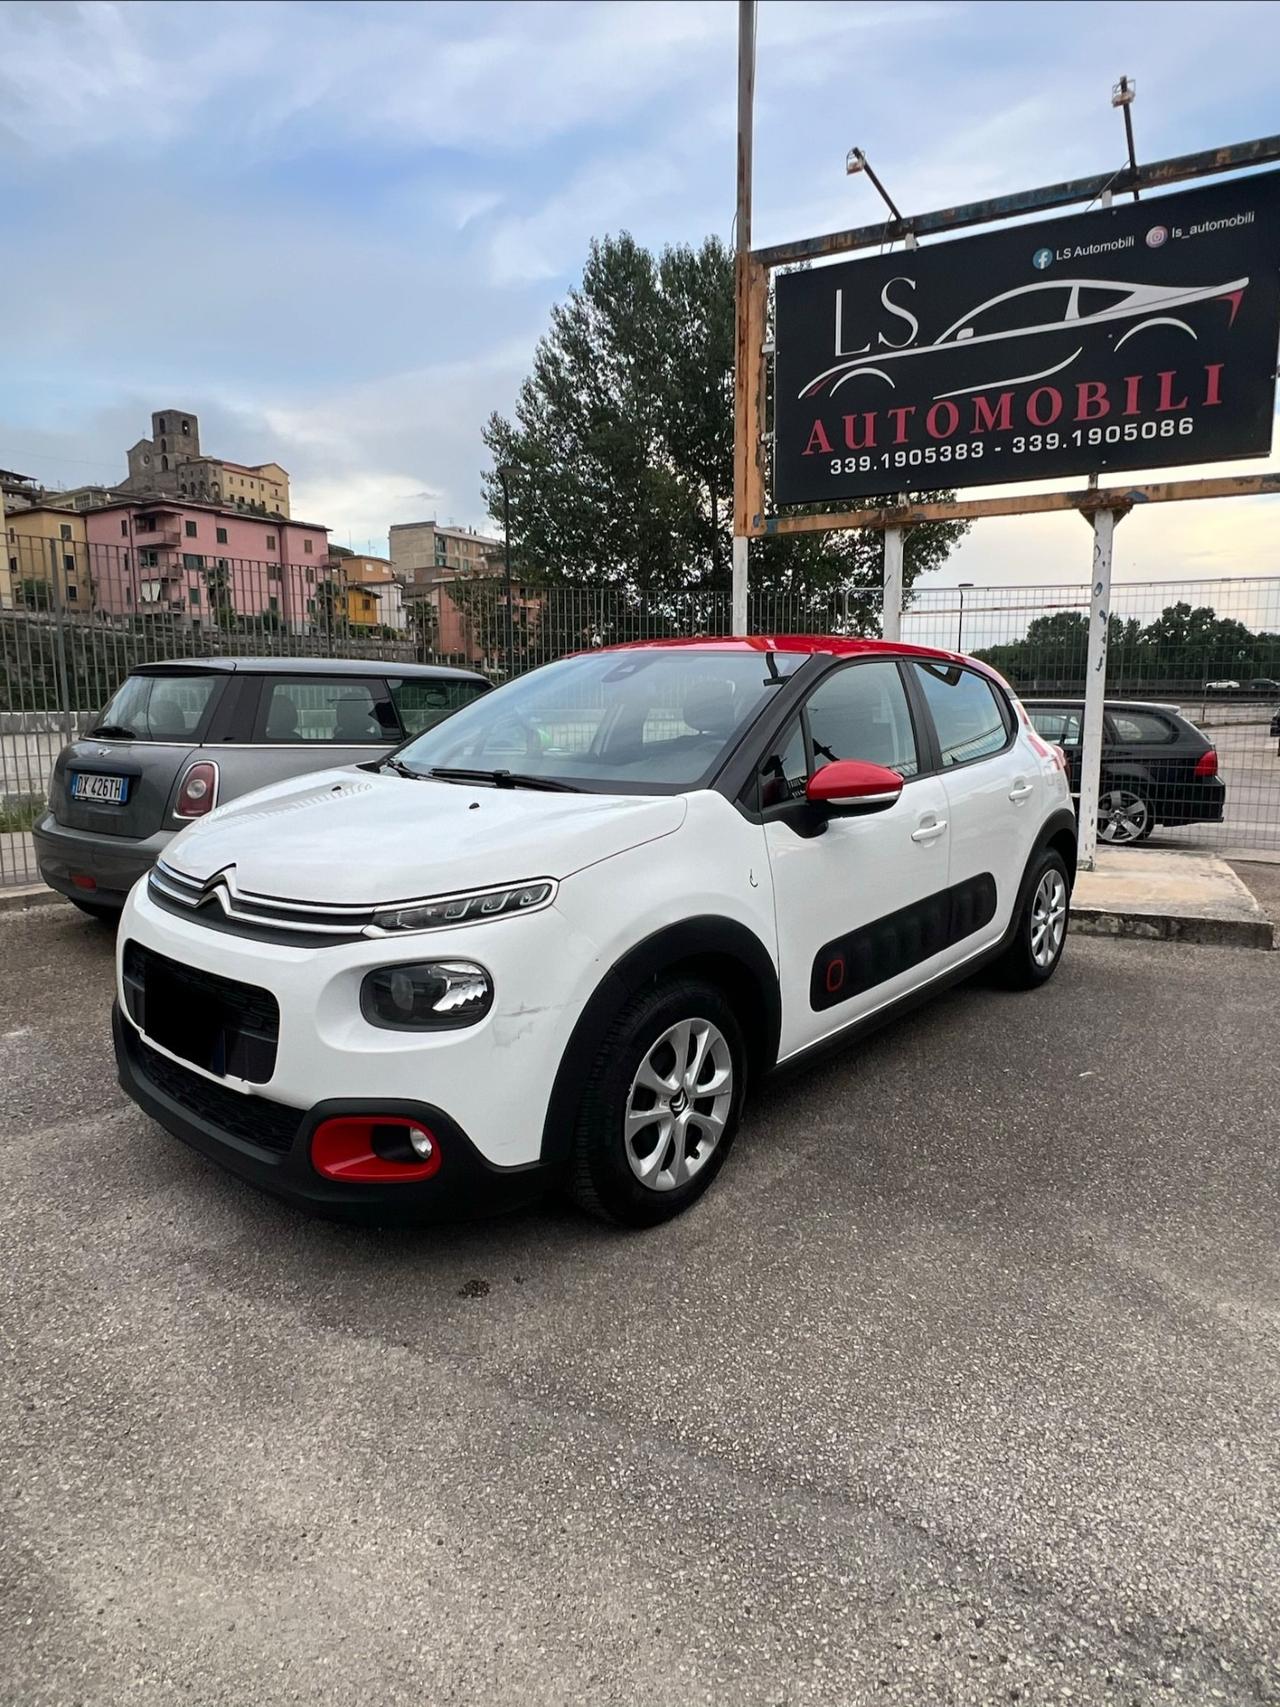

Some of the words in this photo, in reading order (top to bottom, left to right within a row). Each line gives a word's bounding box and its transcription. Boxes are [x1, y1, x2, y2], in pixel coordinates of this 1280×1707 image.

[1171, 211, 1255, 239] ls_automobili
[1056, 249, 1071, 261] LS
[1074, 235, 1135, 257] Automobili
[835, 277, 919, 357] LS
[801, 363, 1225, 456] AUTOMOBILI
[830, 441, 984, 475] 339.1905383
[1012, 417, 1194, 454] 339.1905086
[77, 775, 89, 795] DX
[91, 777, 122, 799] 426TH
